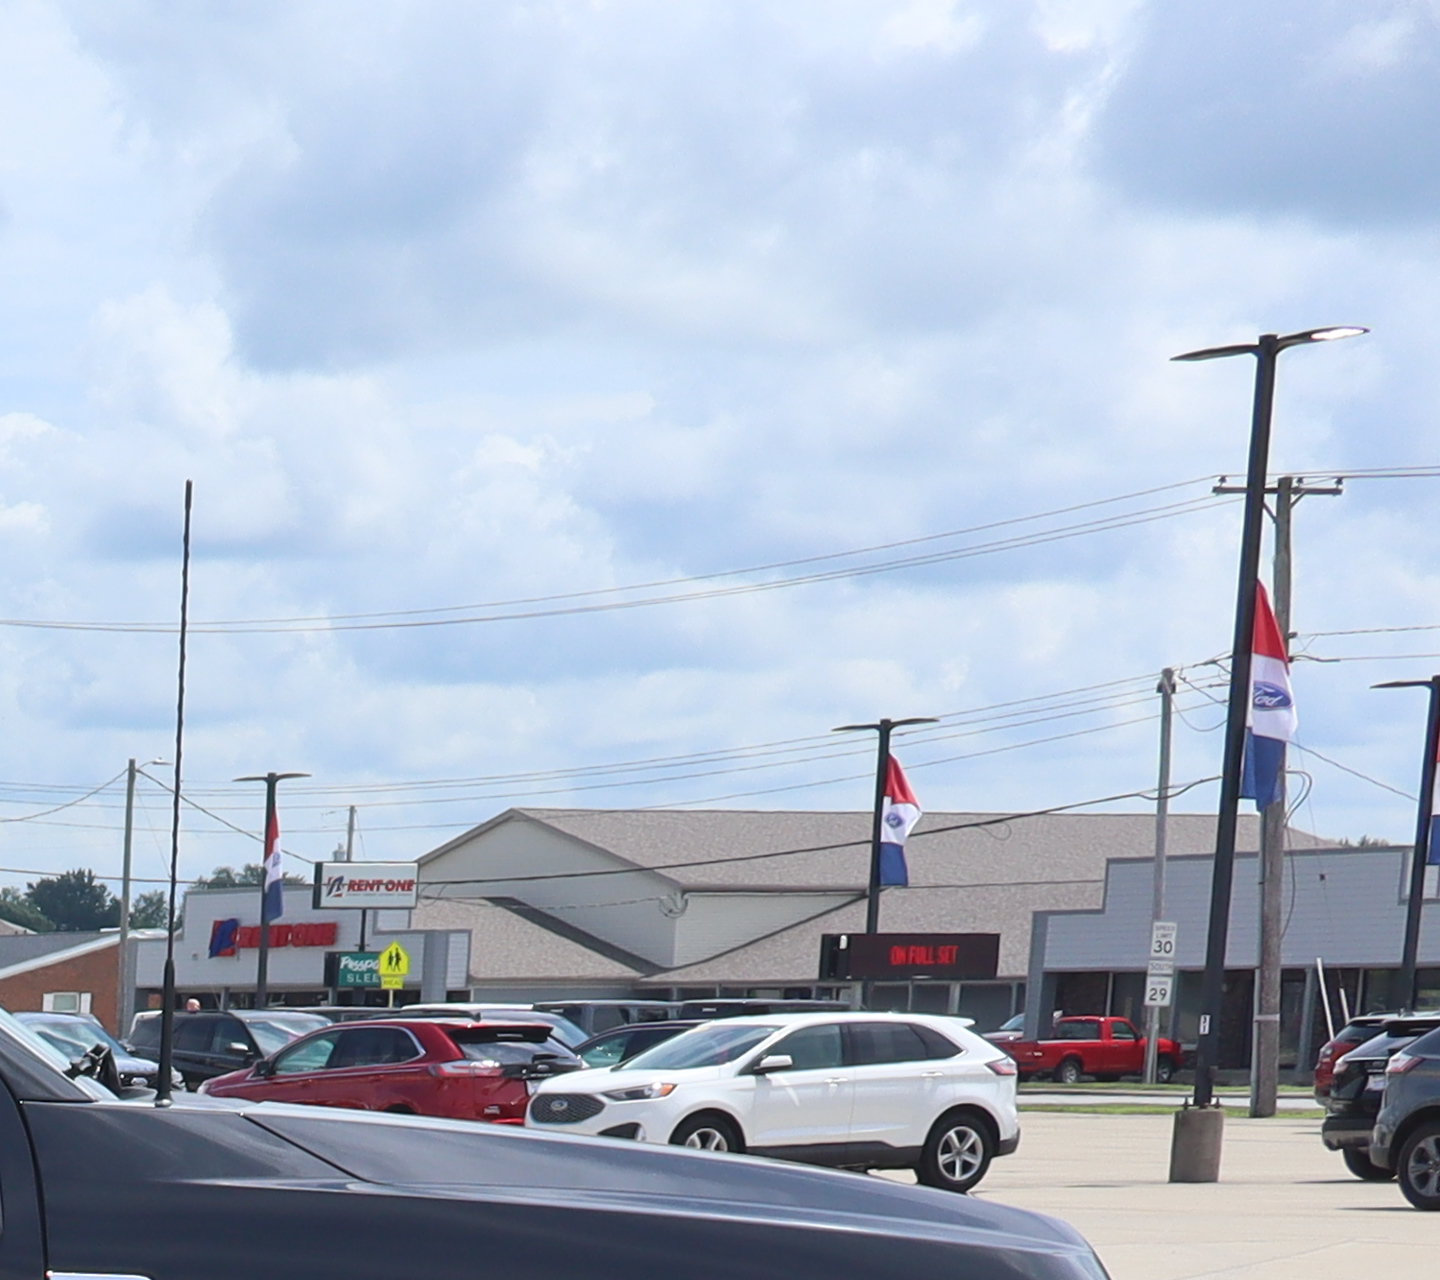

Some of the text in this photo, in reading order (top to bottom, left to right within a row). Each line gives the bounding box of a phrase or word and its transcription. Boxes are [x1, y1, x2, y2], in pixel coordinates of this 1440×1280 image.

[347, 879, 415, 892] RENT ONE
[1153, 940, 1173, 954] 30
[1149, 987, 1168, 1001] 29
